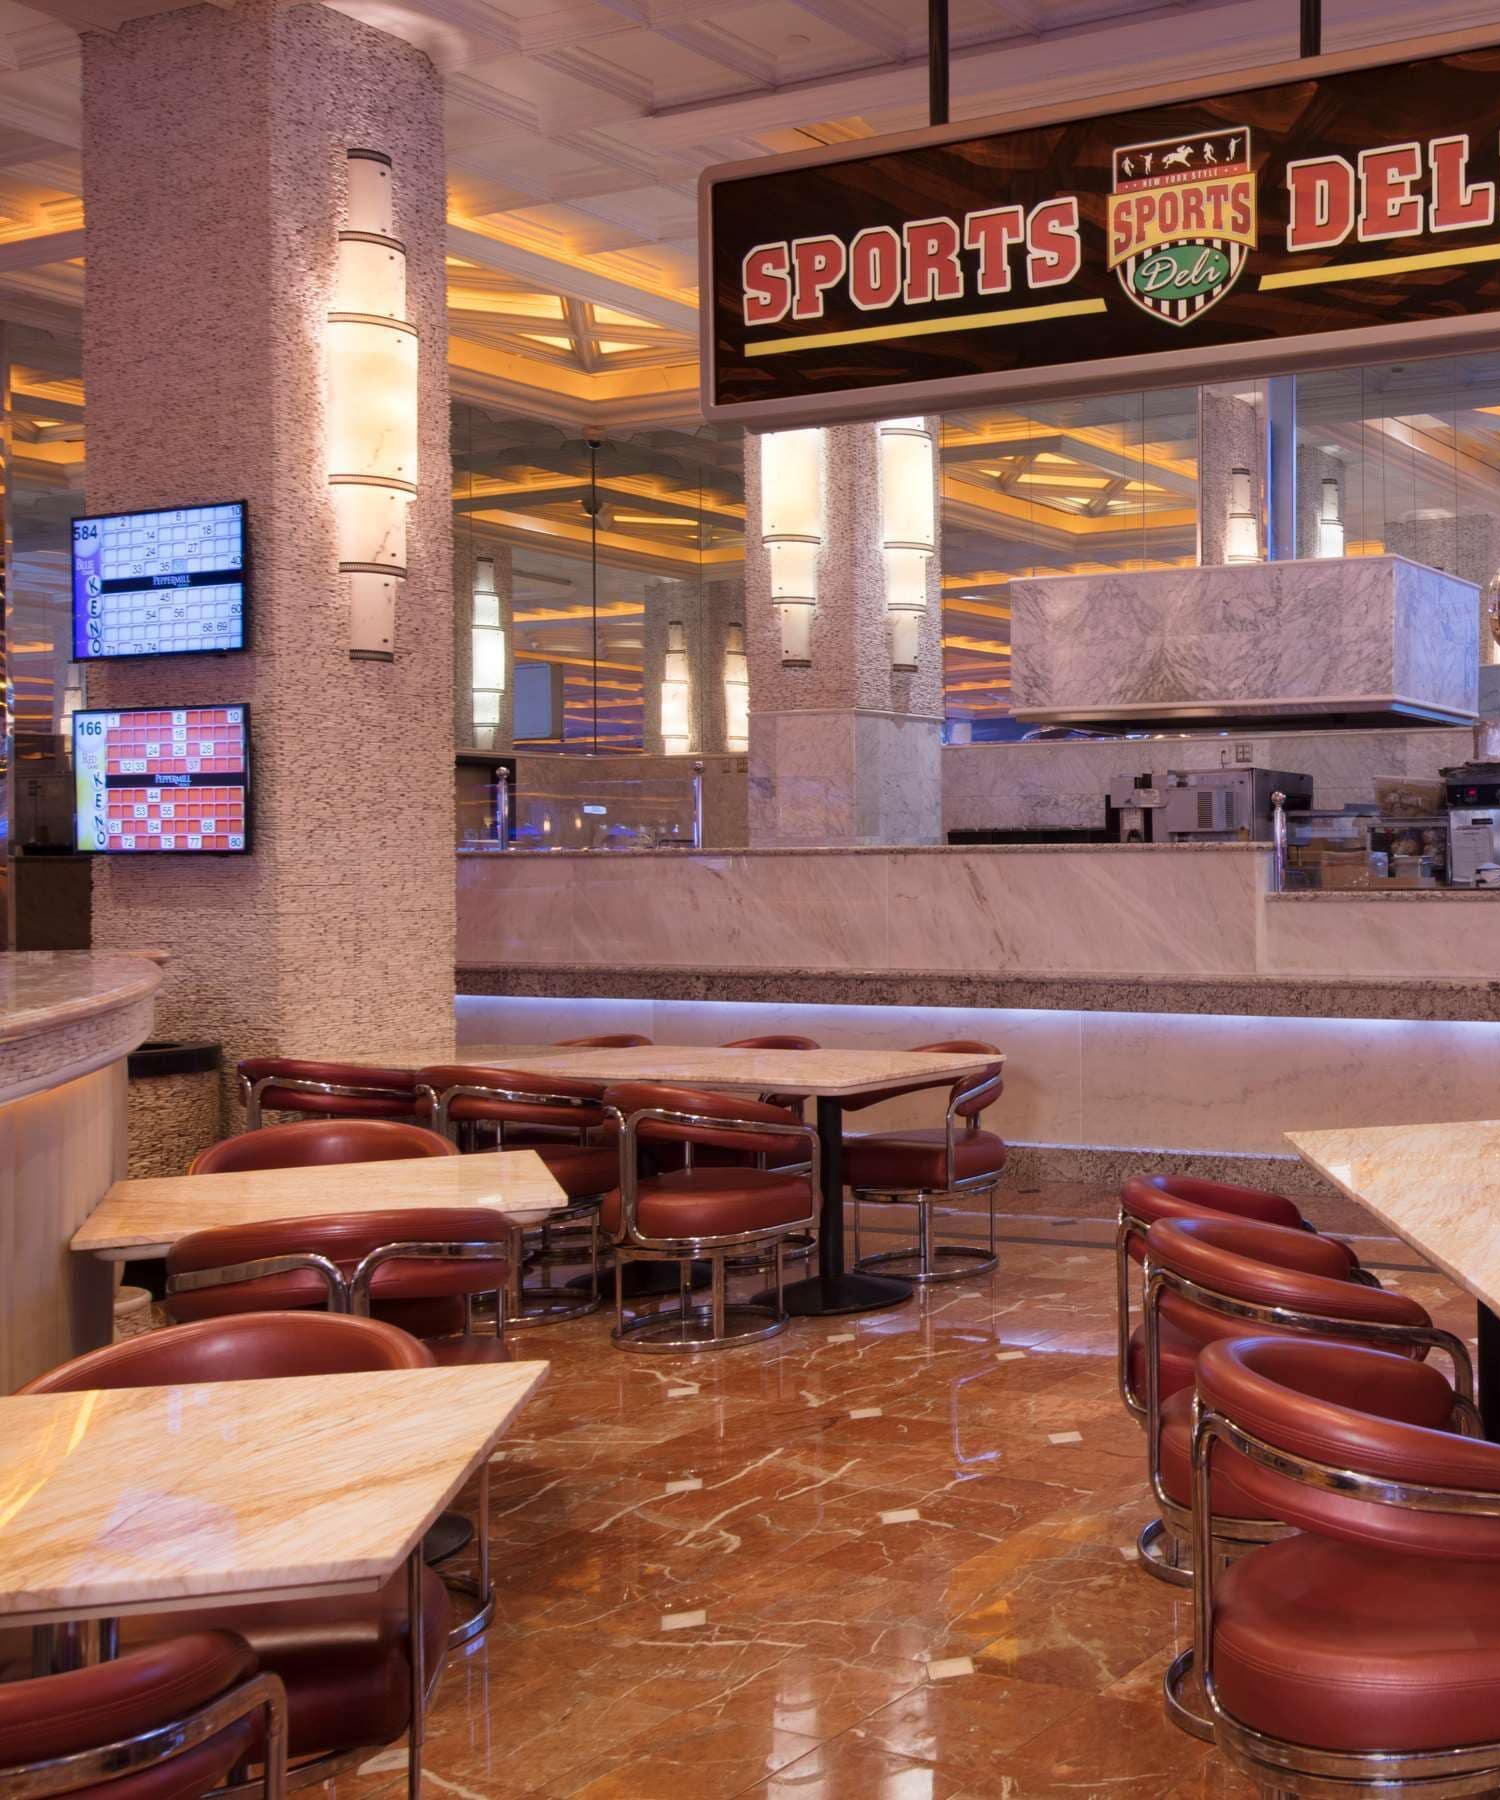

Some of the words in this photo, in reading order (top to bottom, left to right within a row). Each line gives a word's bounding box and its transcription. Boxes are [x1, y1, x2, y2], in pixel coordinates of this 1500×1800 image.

[1143, 176, 1160, 187] NEW
[1165, 173, 1188, 184] YORK
[1191, 169, 1218, 180] STYLE
[1113, 181, 1251, 257] SPORTS
[742, 196, 1081, 326] SPORTS
[1141, 248, 1221, 293] Deli
[121, 517, 127, 527] 2
[176, 511, 183, 522] 6
[232, 506, 242, 516] 10
[73, 524, 99, 542] 584
[147, 530, 156, 540] 14
[203, 525, 213, 535] 18
[147, 547, 157, 557] 24
[189, 543, 198, 553] 27
[134, 564, 143, 574] 33
[161, 562, 171, 572] 35
[231, 555, 242, 565] 40
[161, 593, 172, 602] 45
[90, 577, 102, 654] KENO
[147, 610, 157, 619] 54
[175, 608, 186, 618] 56
[232, 604, 243, 614] 60
[203, 623, 214, 632] 68
[218, 621, 229, 631] 69
[107, 646, 117, 655] 71
[134, 643, 144, 652] 73
[148, 642, 157, 651] 74
[112, 716, 117, 724] 1
[177, 713, 184, 724] 6
[230, 711, 240, 721] 10
[79, 721, 104, 736] 166
[149, 745, 159, 755] 24
[202, 744, 213, 754] 28
[123, 762, 132, 772] 32
[136, 761, 147, 771] 33
[189, 759, 199, 770] 37
[150, 791, 160, 800] 44
[94, 771, 106, 847] KENO
[137, 806, 146, 816] 53
[111, 822, 121, 832] 61
[150, 821, 160, 831] 64
[204, 821, 214, 831] 68
[125, 836, 135, 847] 72
[164, 836, 174, 847] 75
[191, 836, 201, 846] 77
[232, 836, 242, 847] 80
